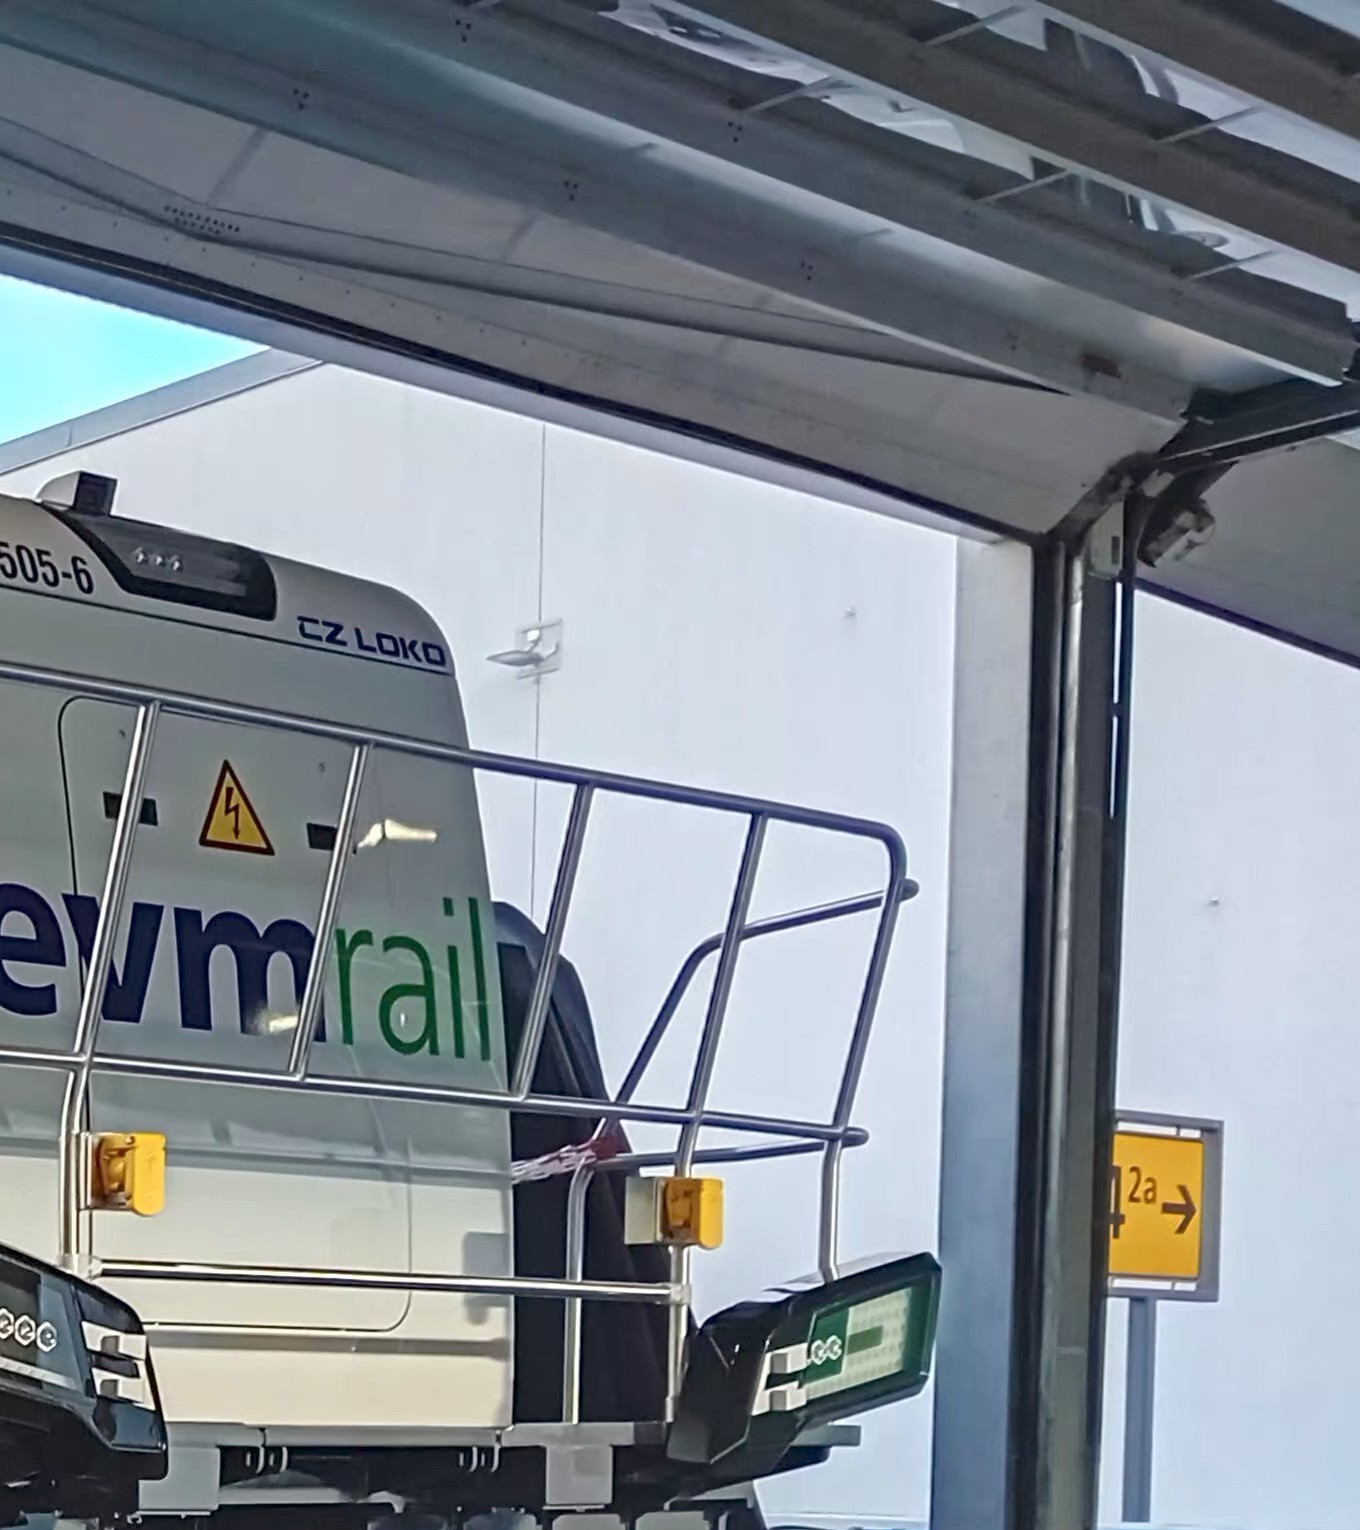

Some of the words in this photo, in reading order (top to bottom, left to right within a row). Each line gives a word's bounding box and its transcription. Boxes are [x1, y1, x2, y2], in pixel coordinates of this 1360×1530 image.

[296, 616, 348, 647] CZ
[355, 626, 446, 667] LOKO
[1128, 1166, 1158, 1205] 2a
